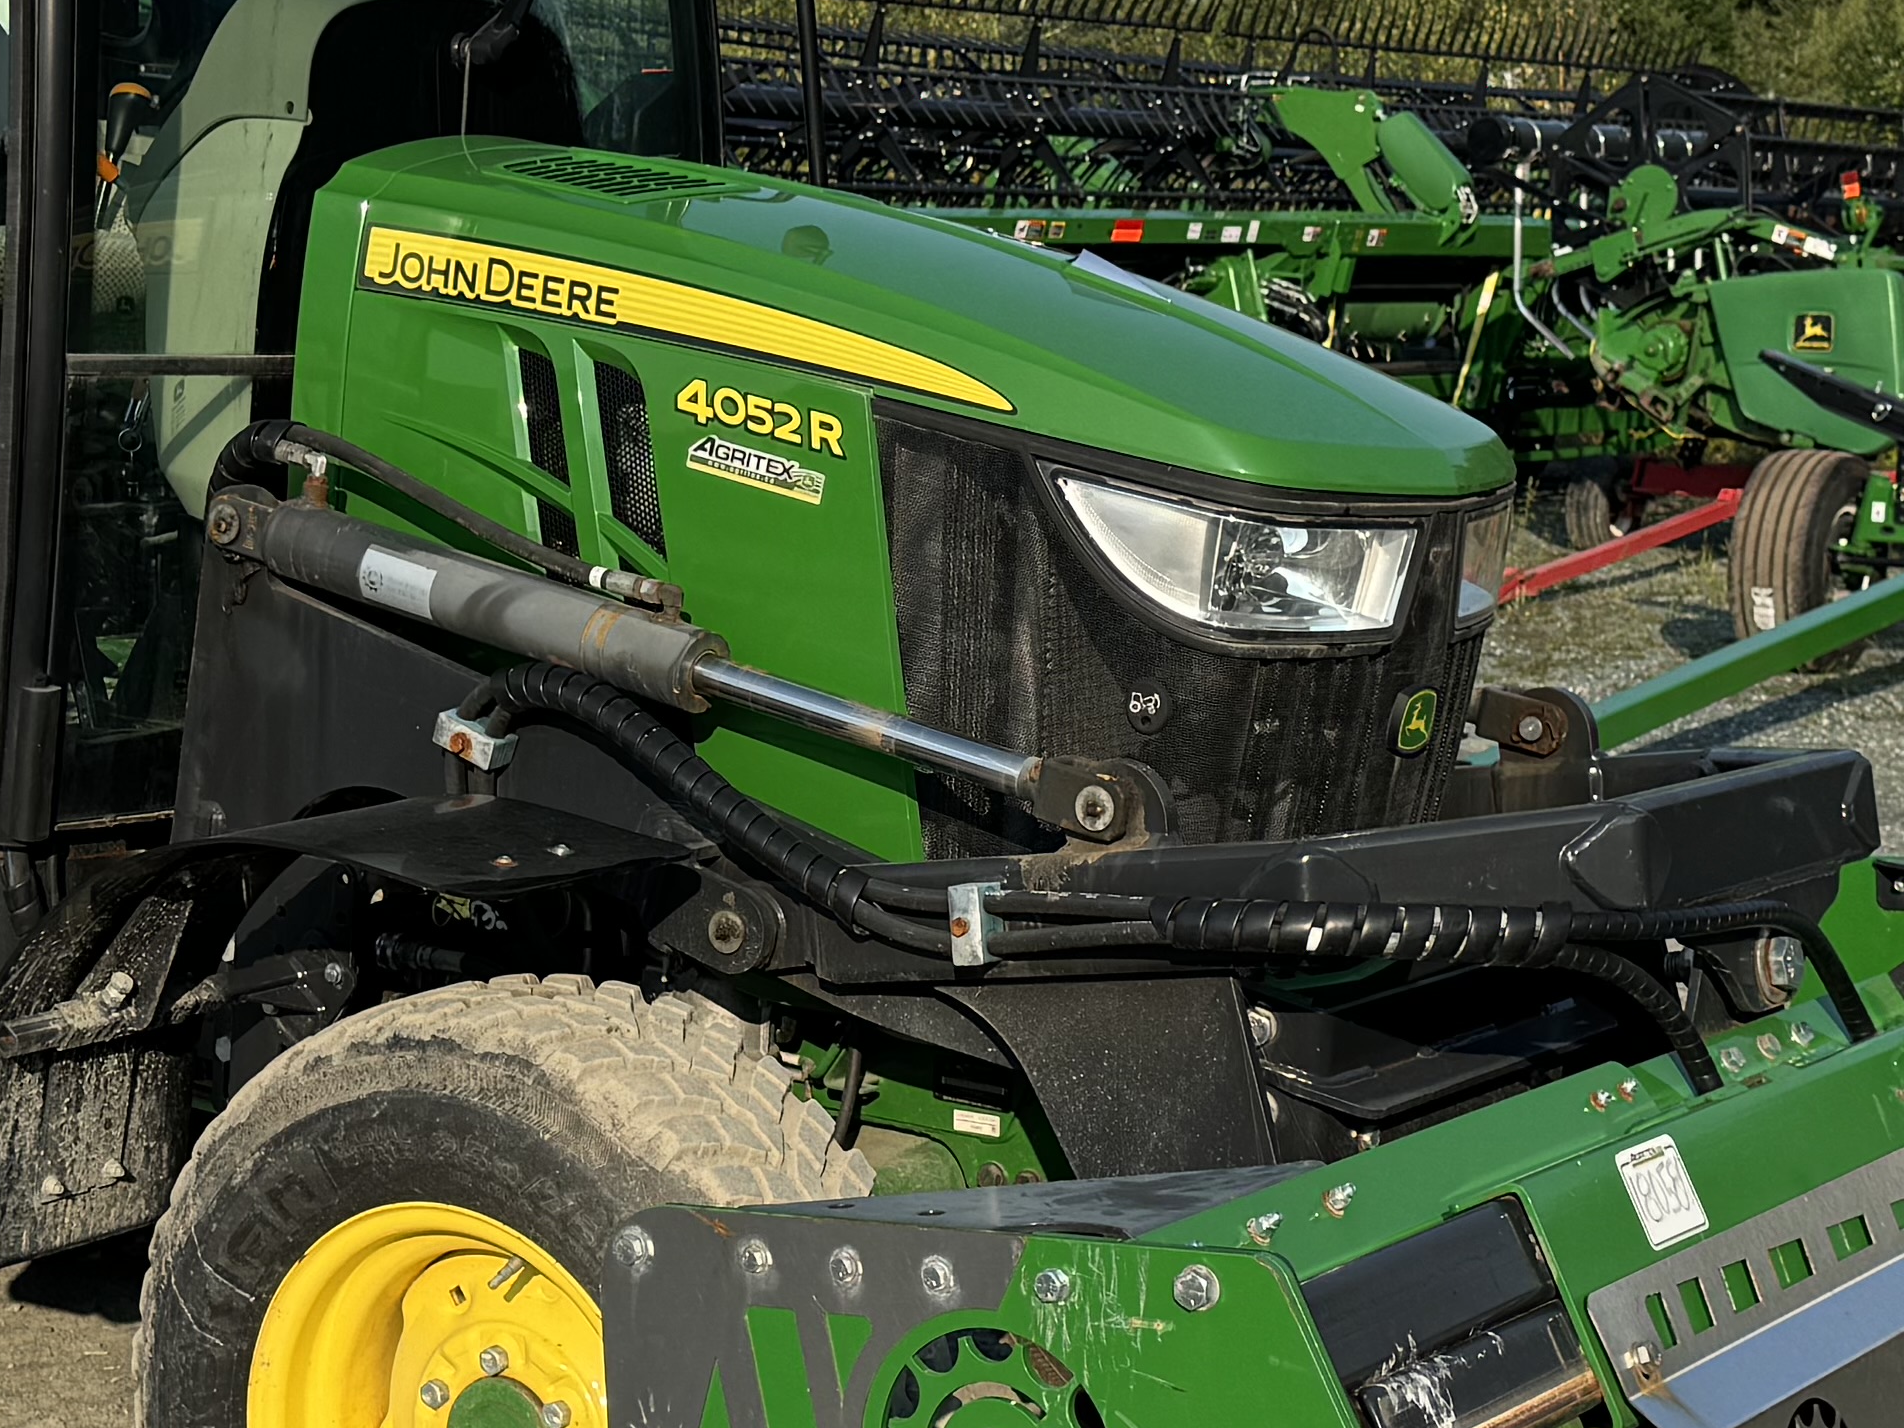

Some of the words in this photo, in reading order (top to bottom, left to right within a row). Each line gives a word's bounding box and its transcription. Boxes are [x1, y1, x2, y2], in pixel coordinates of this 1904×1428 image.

[378, 242, 480, 296] JOHN
[484, 257, 621, 320] DEERE
[692, 436, 796, 480] AGRITEX
